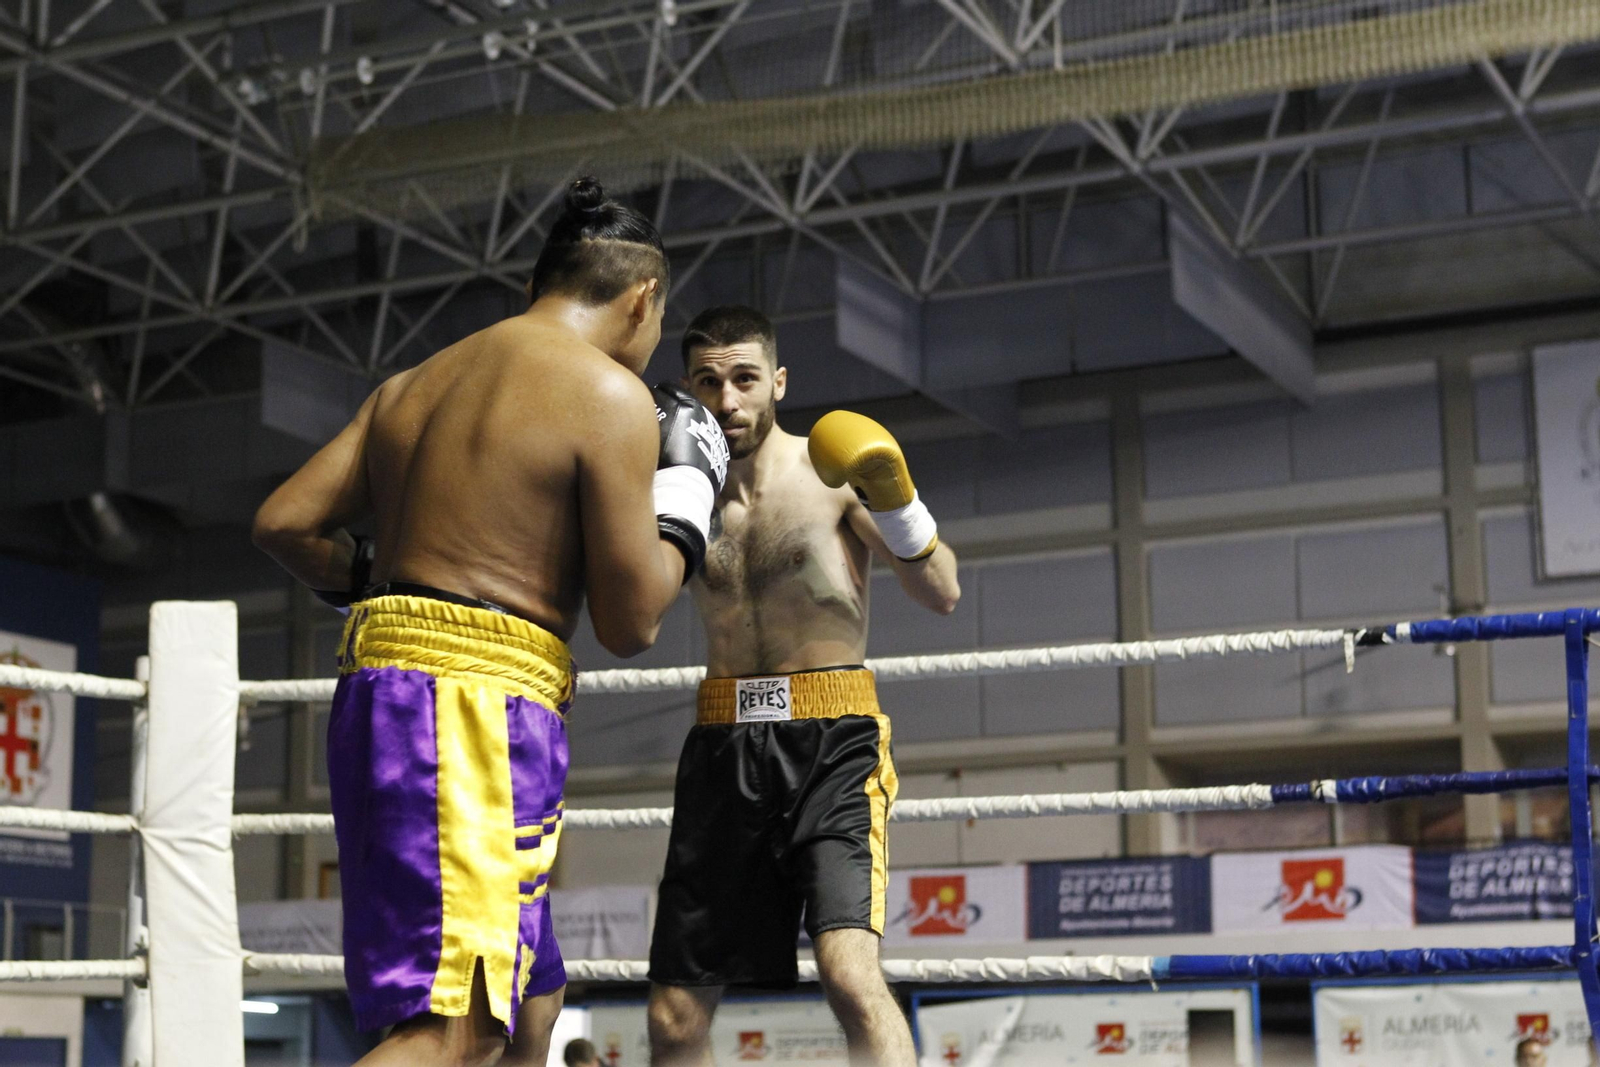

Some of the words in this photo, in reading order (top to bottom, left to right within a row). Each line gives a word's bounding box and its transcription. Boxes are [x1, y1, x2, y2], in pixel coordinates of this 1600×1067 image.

[739, 687, 787, 716] REYES
[1449, 855, 1573, 880] DEPORTES
[1059, 874, 1172, 895] DEPORTES
[1449, 880, 1478, 899] DE
[1059, 896, 1084, 913] DE
